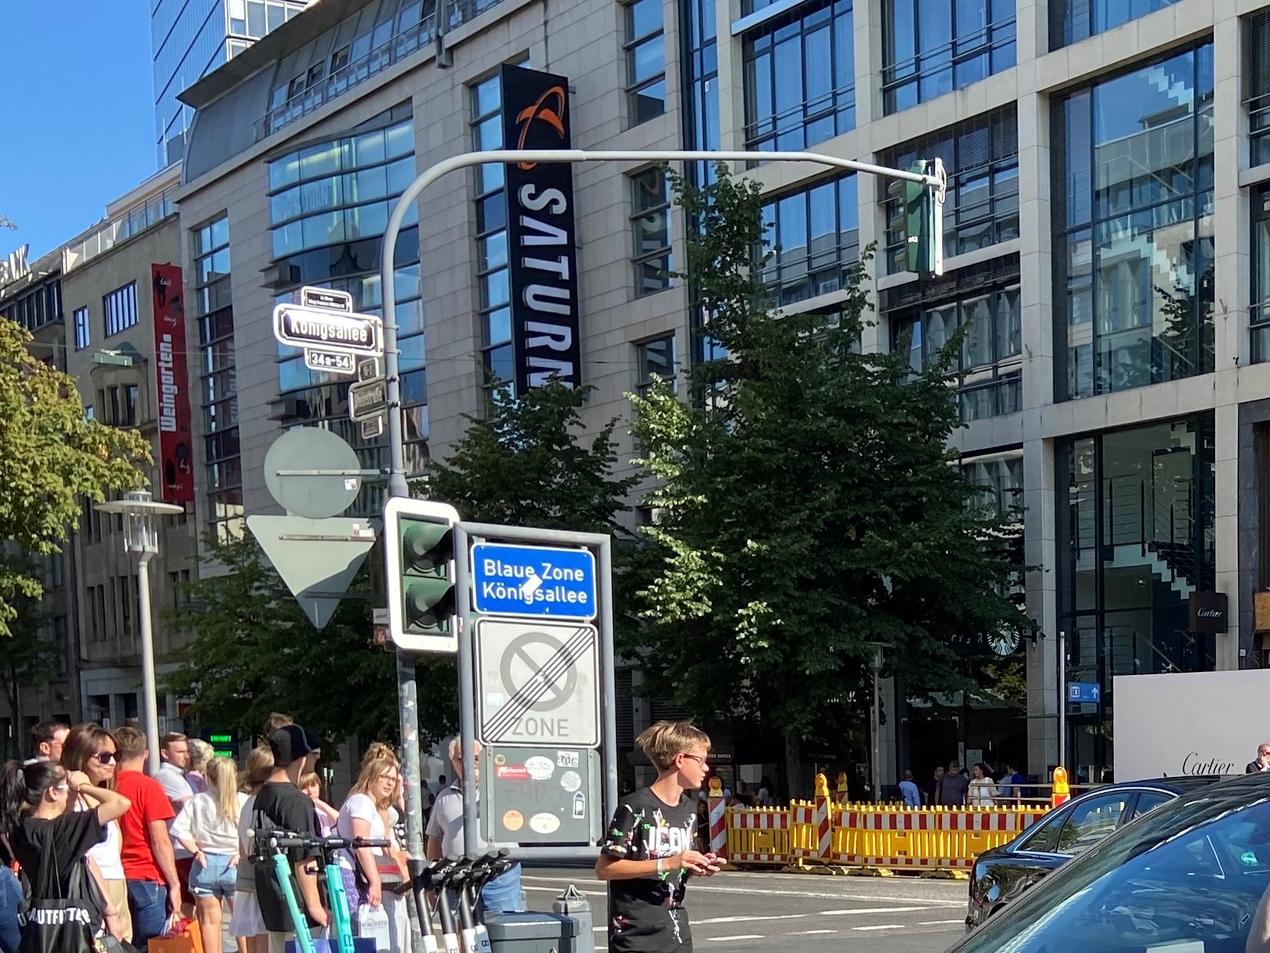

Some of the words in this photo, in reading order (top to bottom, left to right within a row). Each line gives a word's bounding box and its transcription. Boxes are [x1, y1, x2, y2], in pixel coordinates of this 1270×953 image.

[517, 183, 575, 391] SATURN
[312, 352, 350, 368] 34a-54
[483, 559, 536, 578] Blaue
[541, 563, 585, 582] Zone
[1197, 607, 1224, 618] Cartier
[512, 717, 569, 737] ZONE
[1182, 751, 1235, 775] Cartier
[649, 826, 692, 851] ICON
